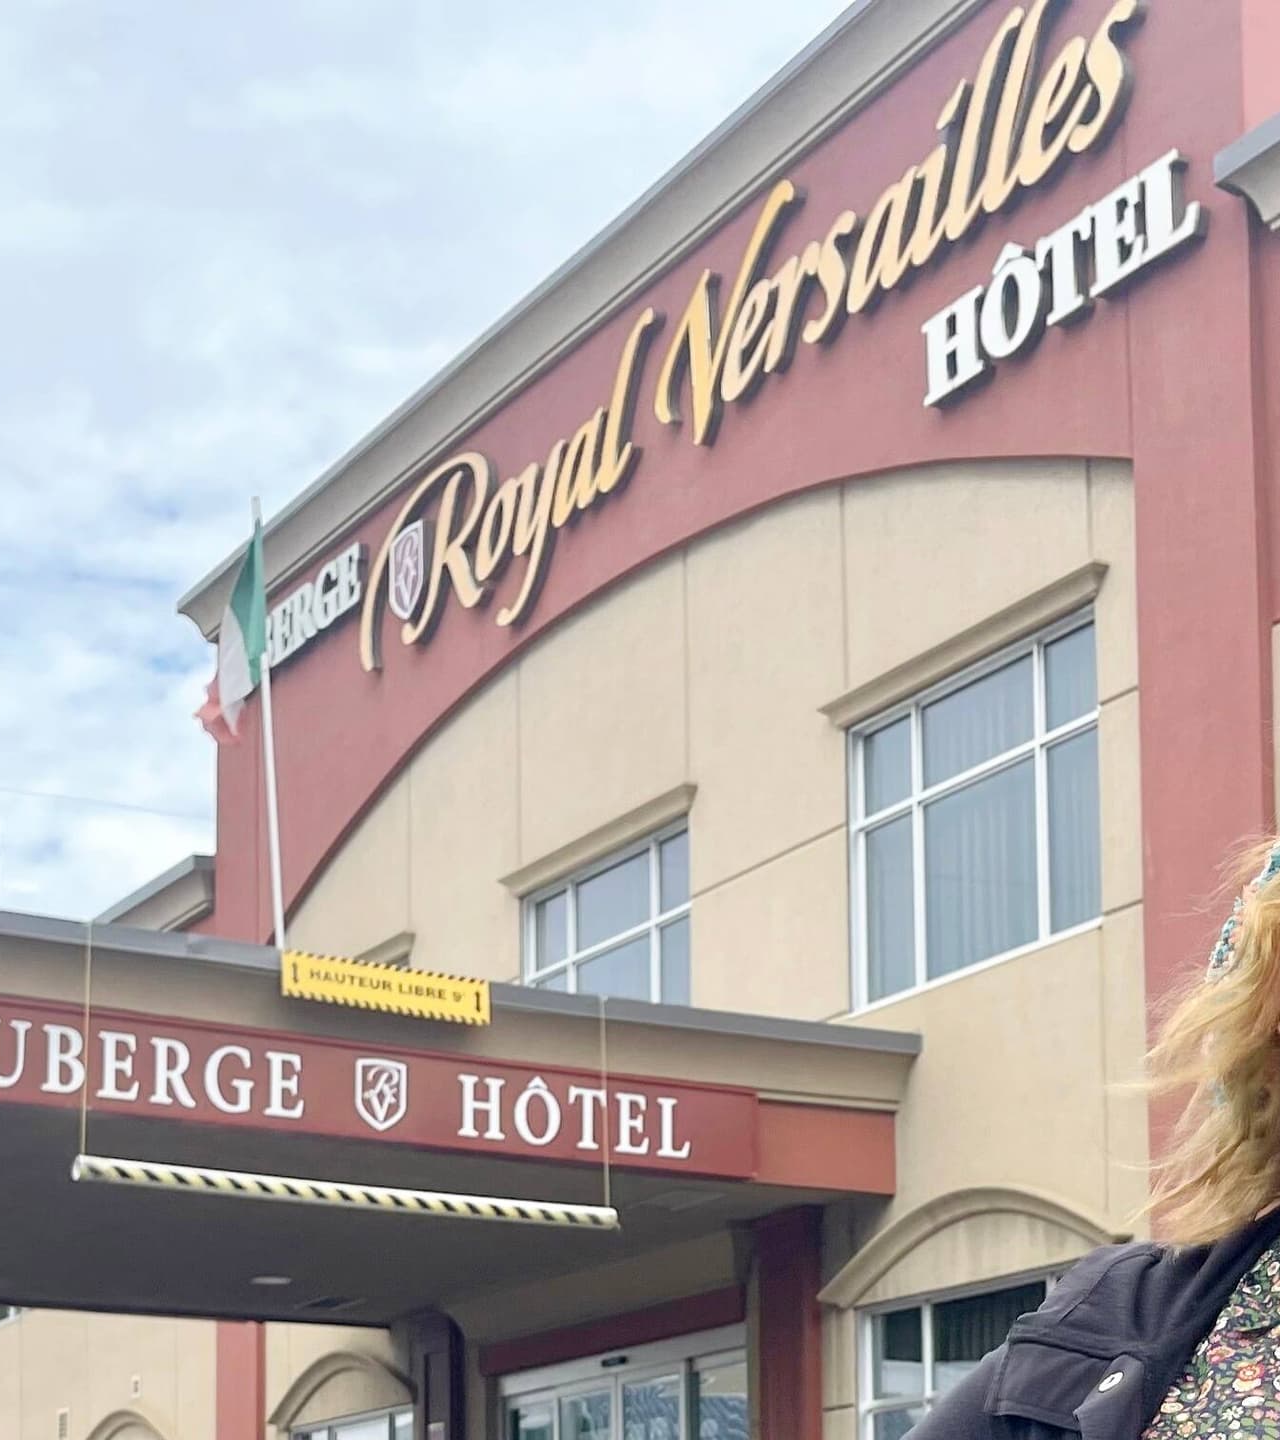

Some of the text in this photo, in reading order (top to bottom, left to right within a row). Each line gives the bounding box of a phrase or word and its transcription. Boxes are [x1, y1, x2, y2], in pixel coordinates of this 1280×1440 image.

[360, 307, 655, 672] Royal
[654, 0, 1138, 447] Versailles
[921, 148, 1201, 408] HÔTEL
[309, 968, 393, 993] HAUTEUR
[398, 982, 447, 1000] LIBRE
[457, 1073, 691, 1159] HÔTEL
